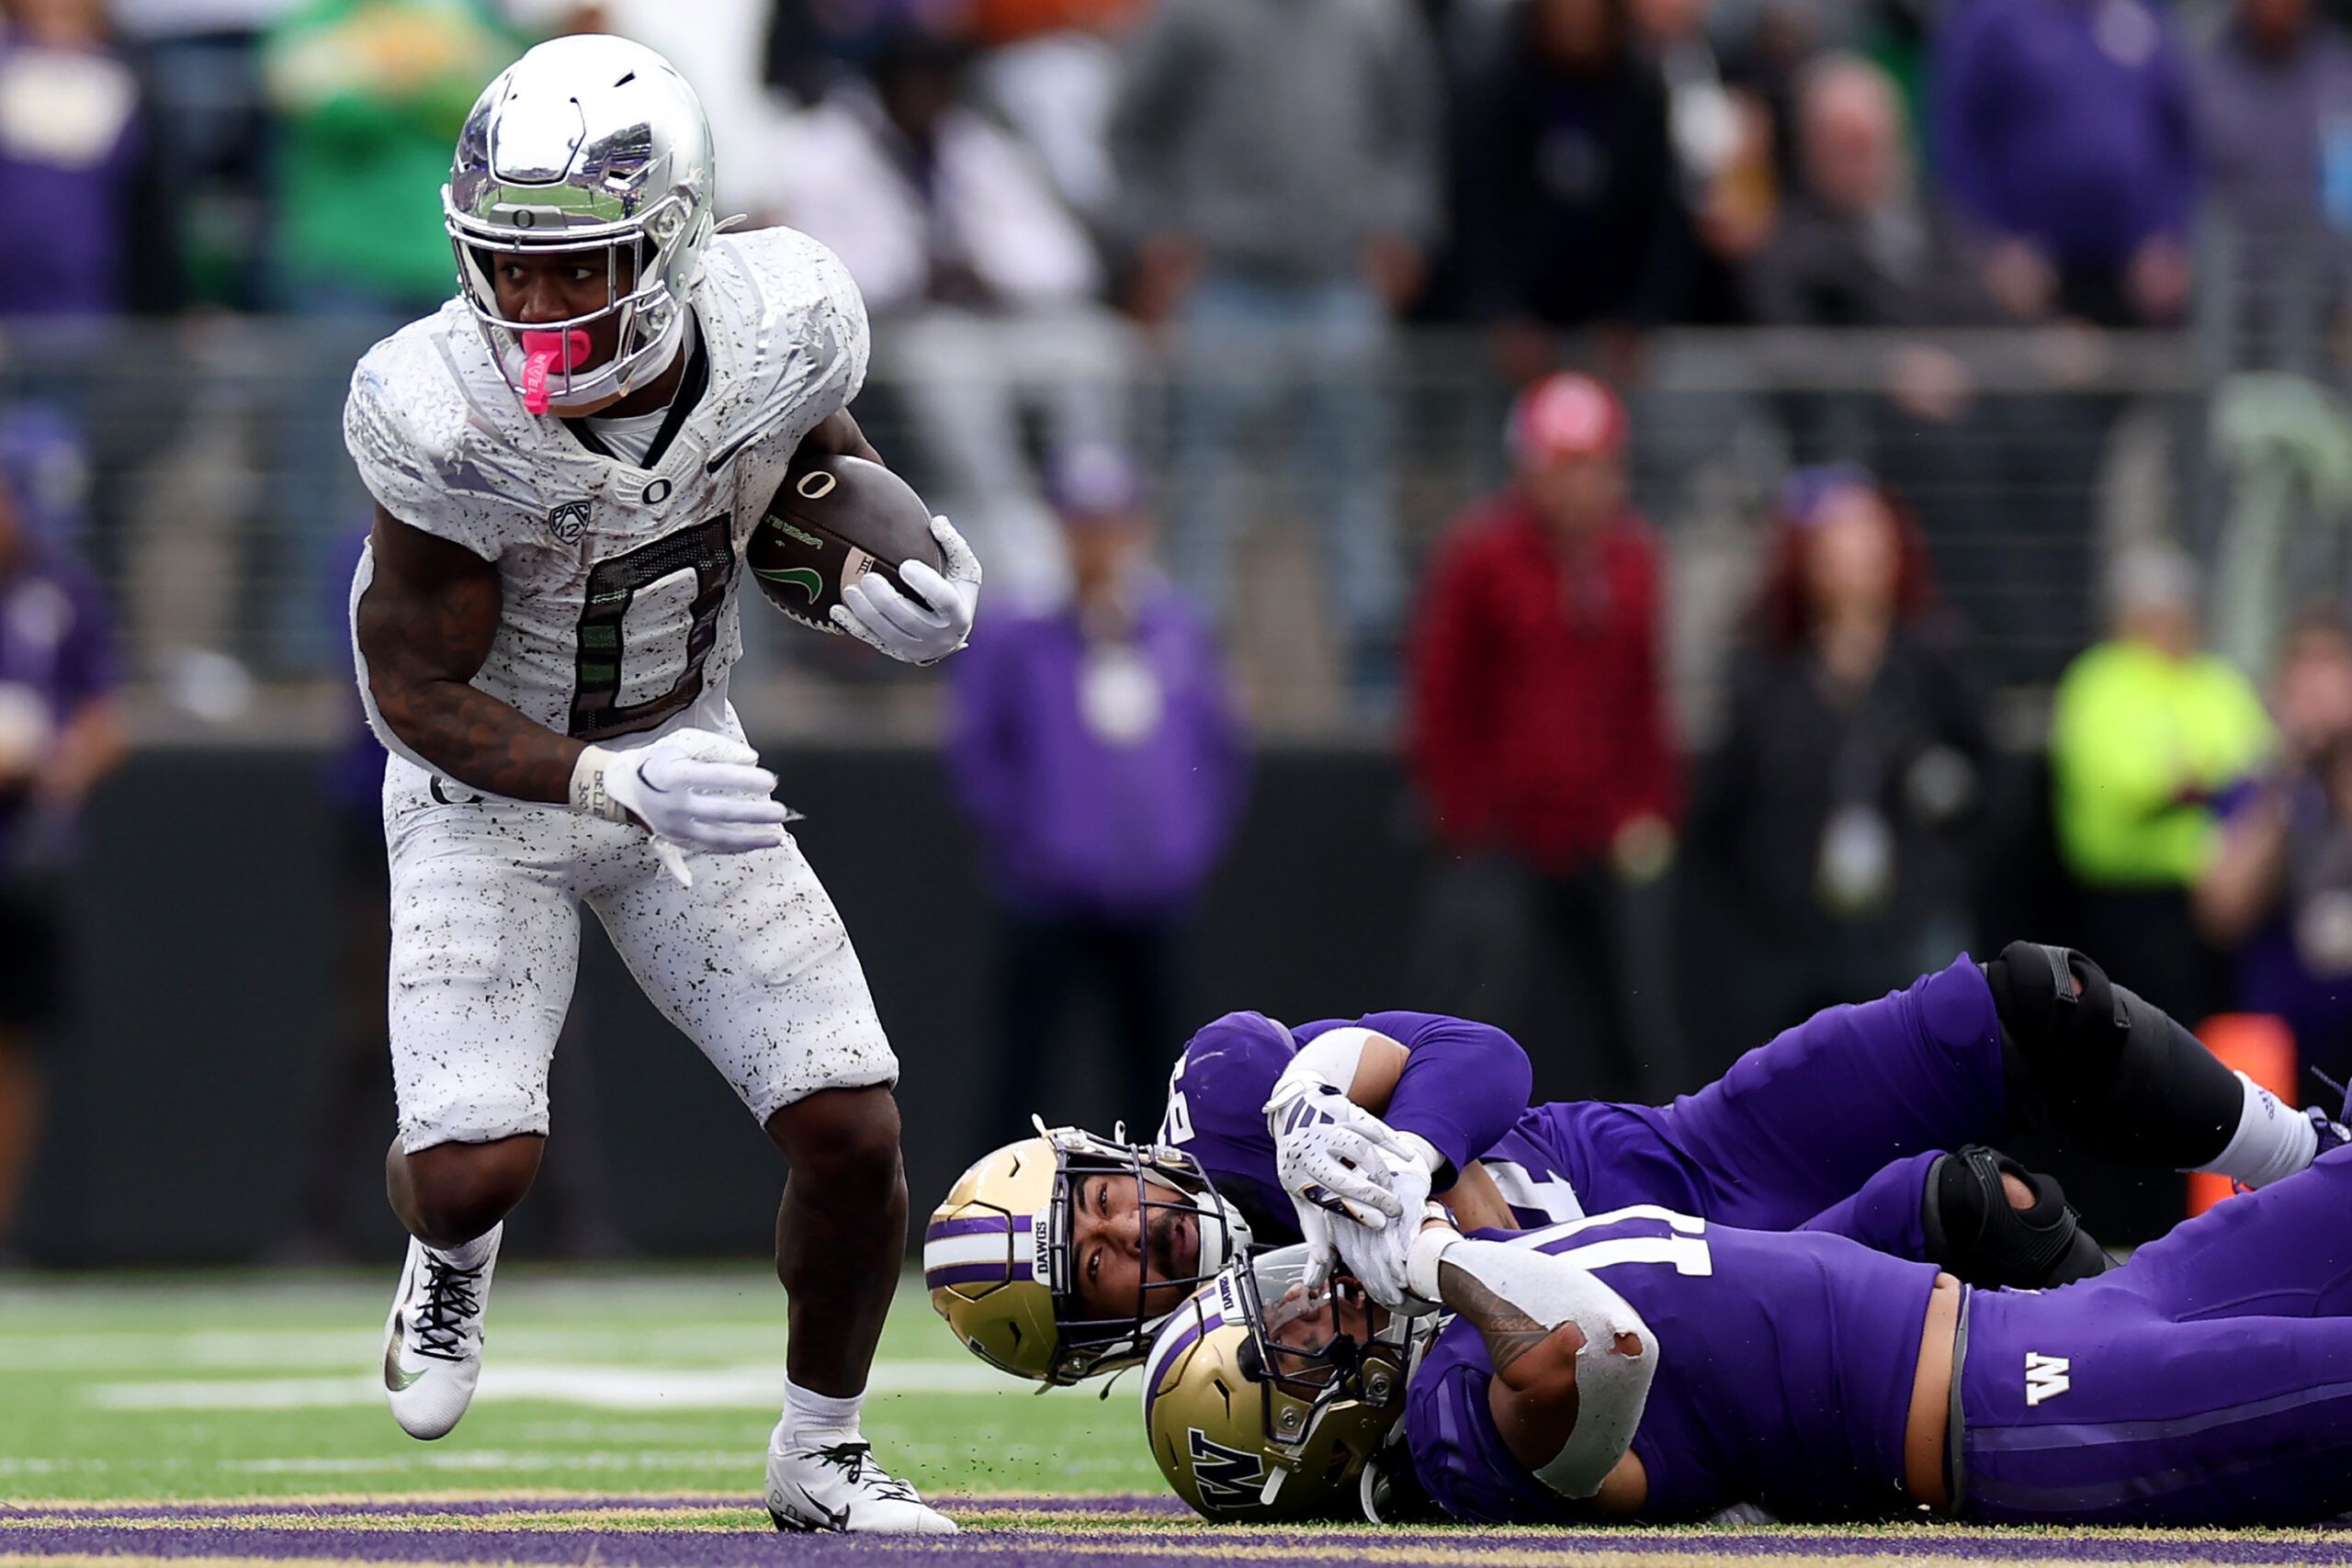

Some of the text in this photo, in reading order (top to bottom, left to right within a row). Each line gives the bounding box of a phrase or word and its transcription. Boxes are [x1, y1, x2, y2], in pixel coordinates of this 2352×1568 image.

[642, 479, 672, 504] O
[797, 471, 836, 499] O
[560, 524, 581, 536] 12
[1035, 1221, 1049, 1274] DAWGS
[2025, 1351, 2070, 1406] W
[1188, 1427, 1265, 1511] W
